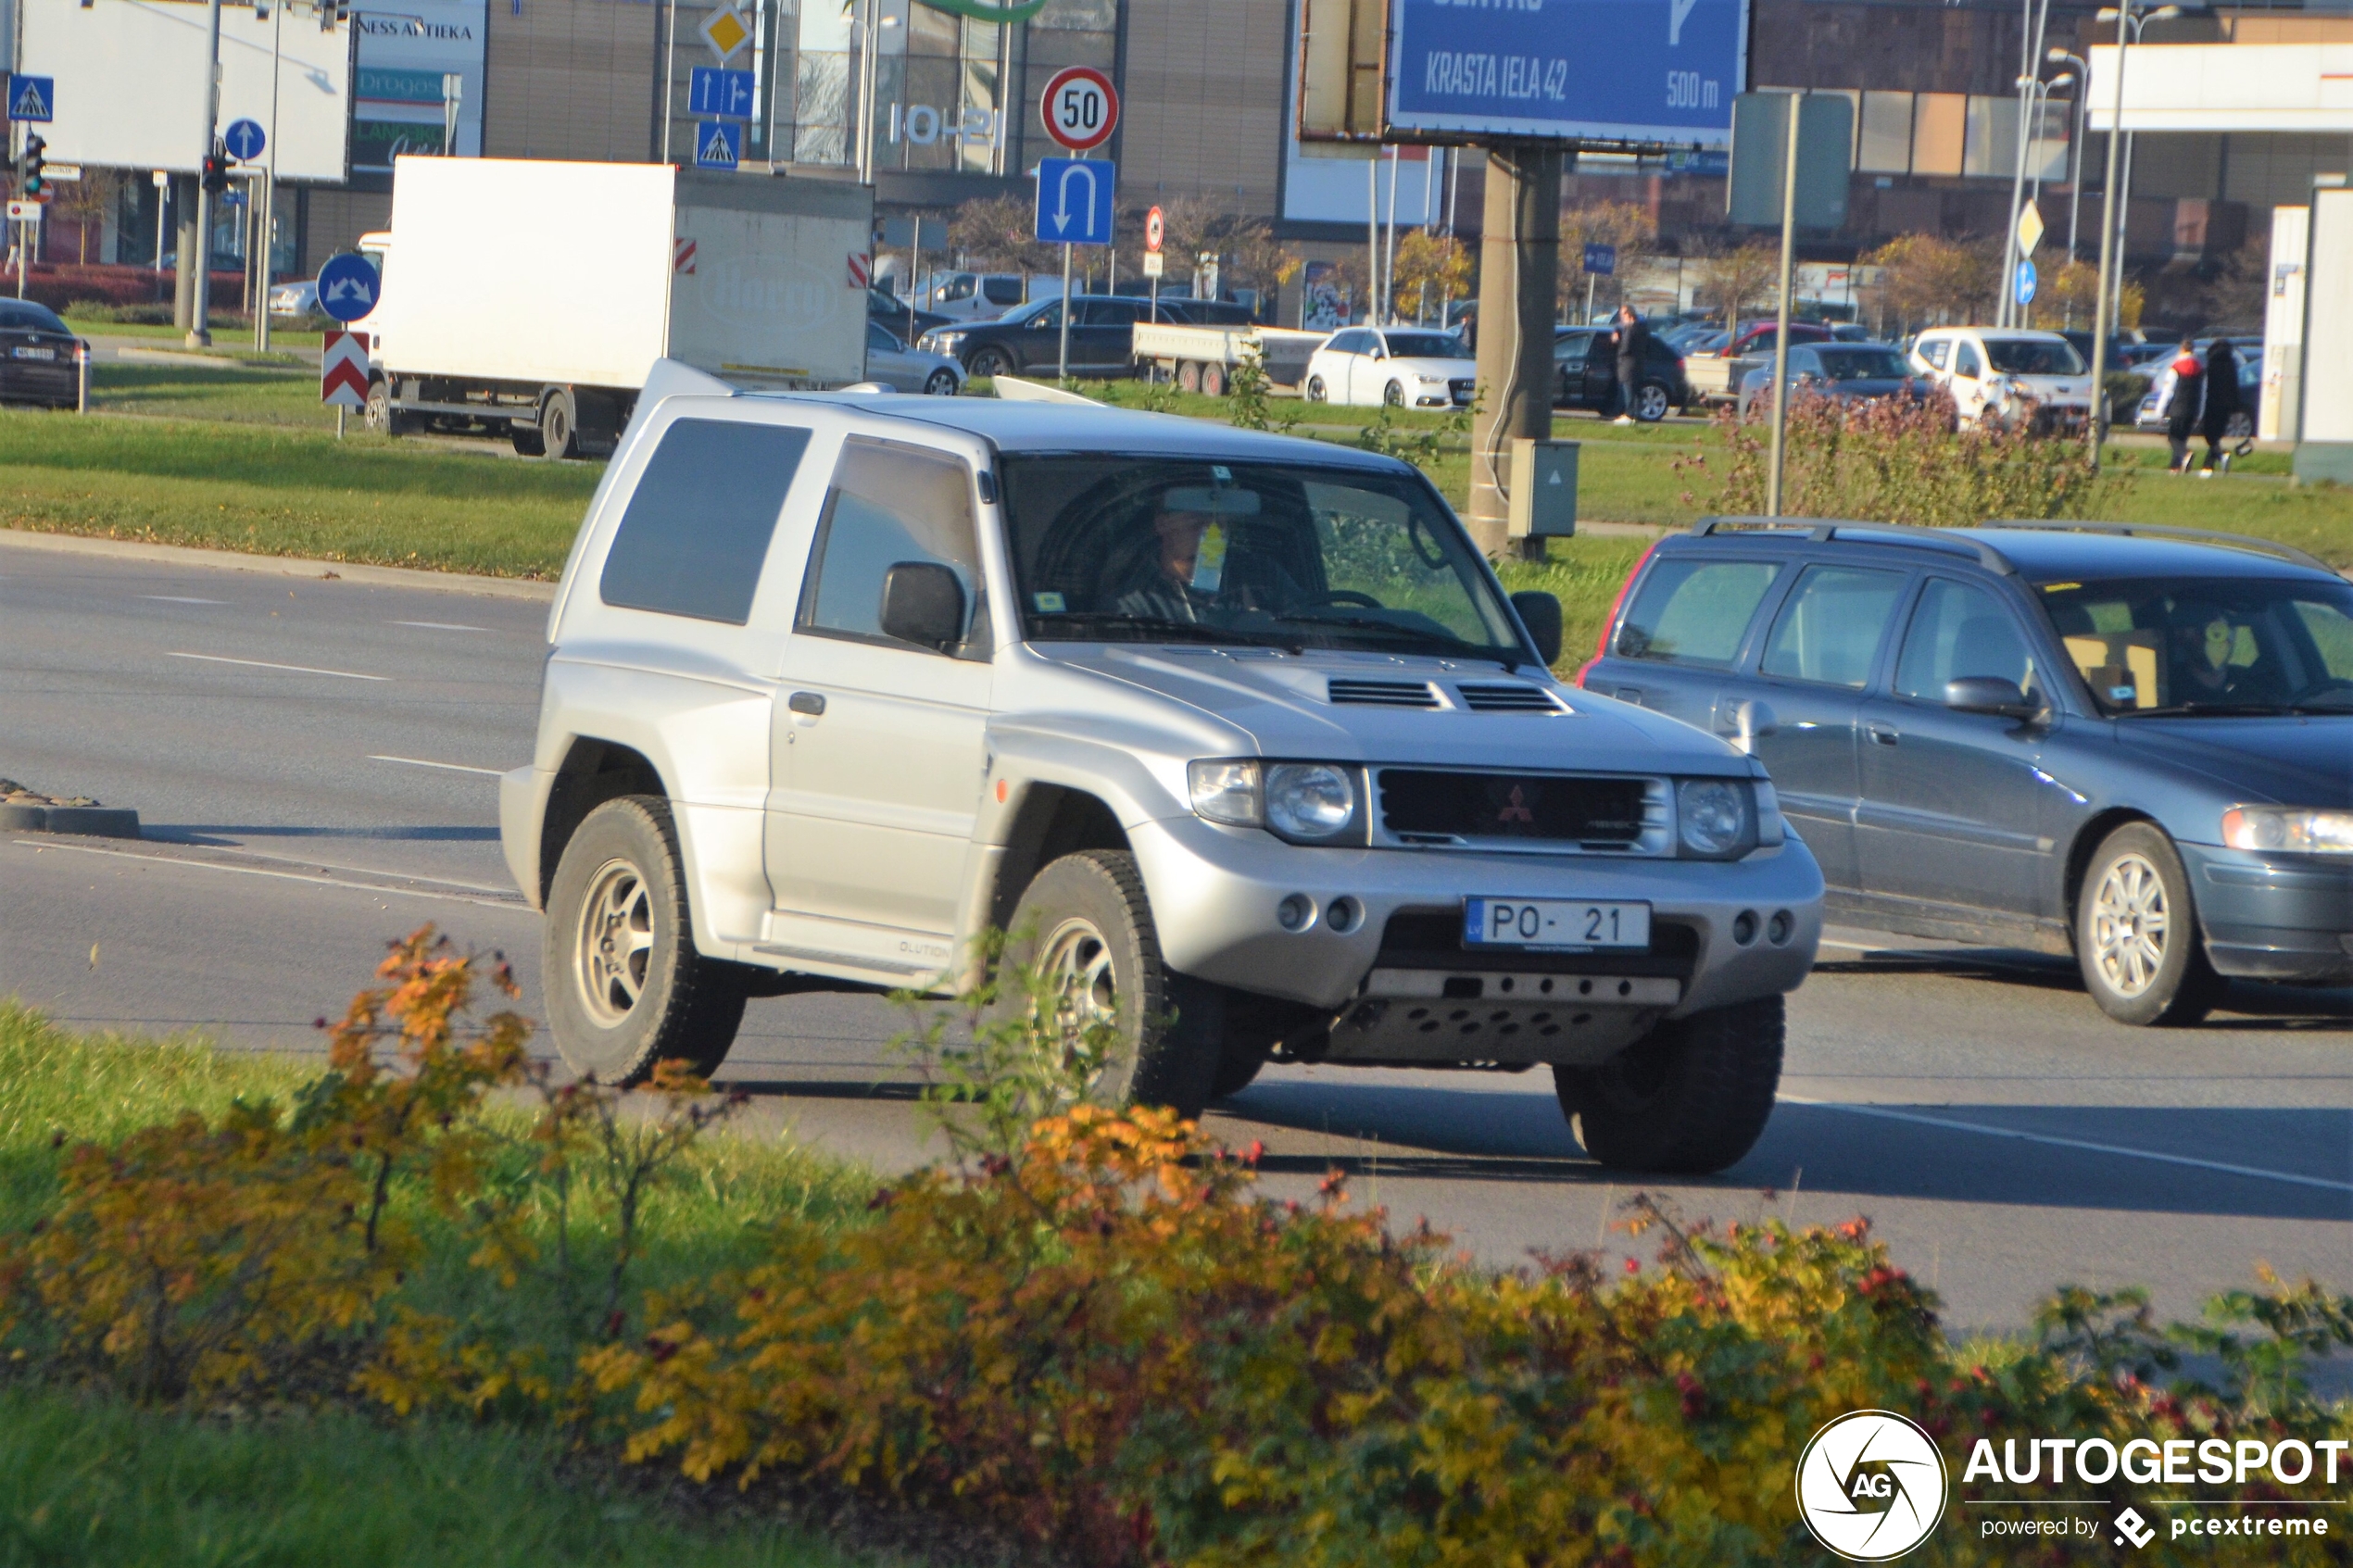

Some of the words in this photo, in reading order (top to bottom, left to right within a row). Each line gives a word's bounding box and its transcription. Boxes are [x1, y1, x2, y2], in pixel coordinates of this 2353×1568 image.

[359, 73, 441, 96] Drogas
[1426, 51, 1497, 96] KRASTA
[1501, 55, 1541, 100] IELA
[1543, 58, 1567, 101] 42
[1667, 70, 1700, 107] 500
[1703, 80, 1718, 108] m
[889, 102, 1003, 149] 10-21
[1063, 89, 1100, 129] 50
[1467, 924, 1483, 935] LV
[1585, 908, 1621, 941] 21
